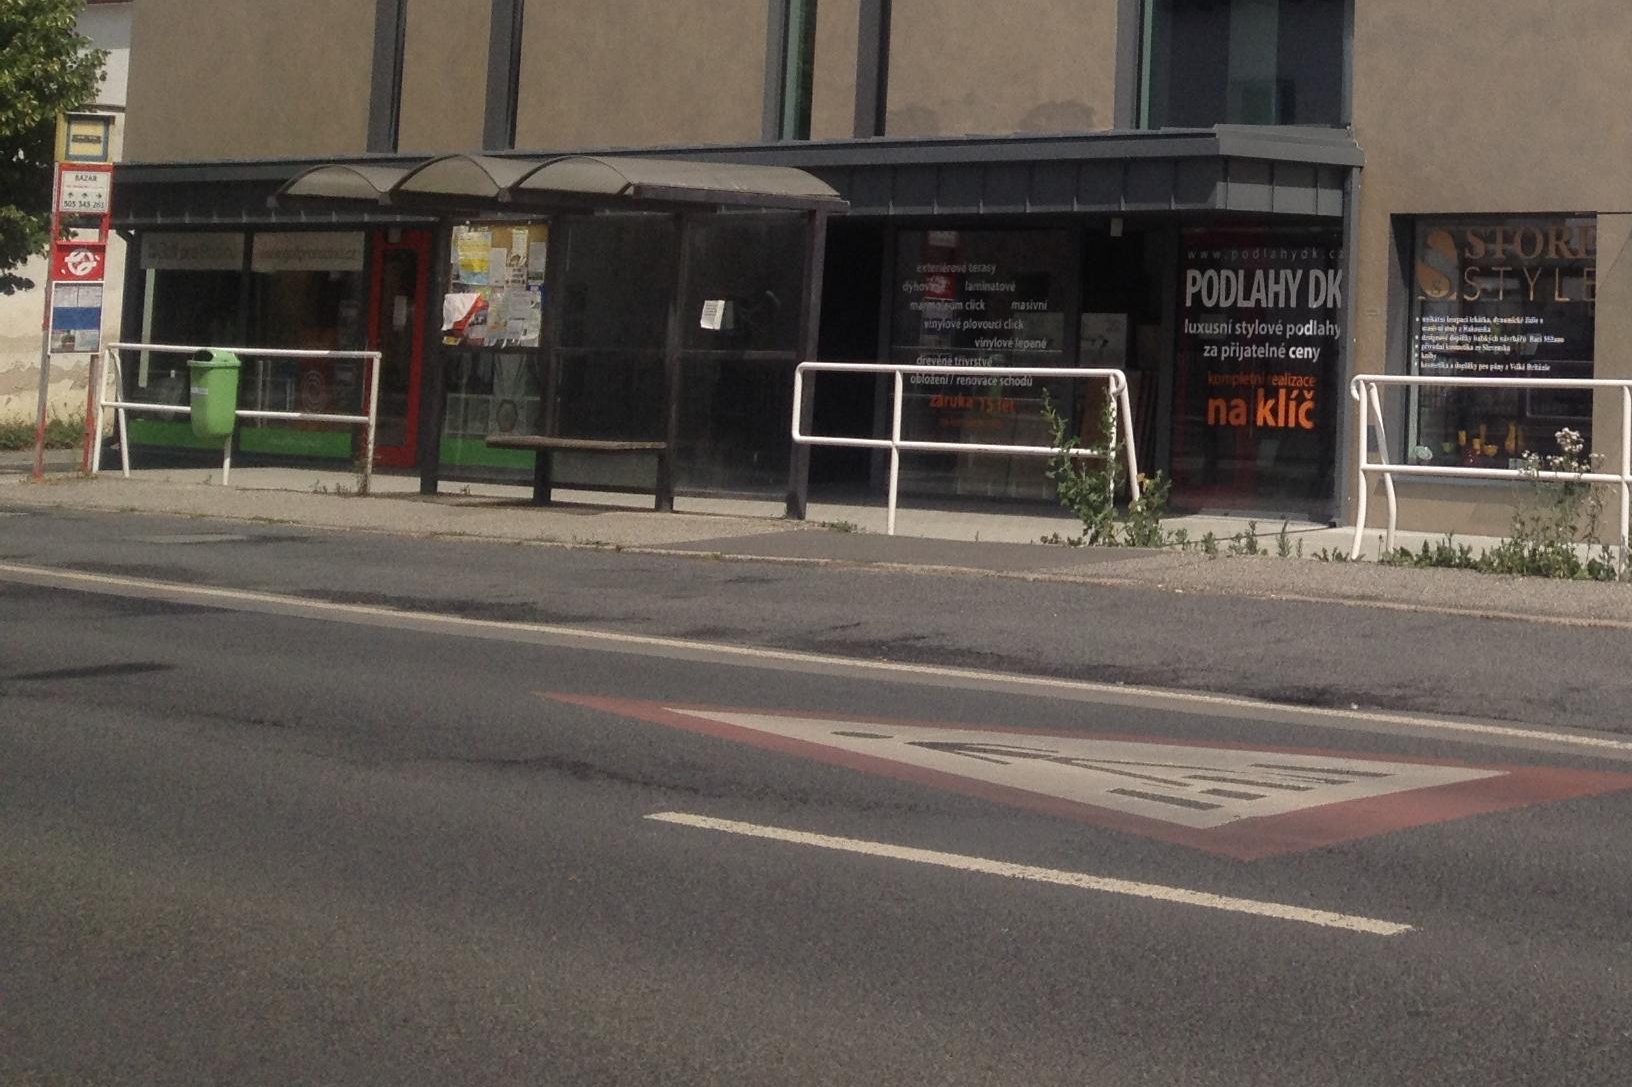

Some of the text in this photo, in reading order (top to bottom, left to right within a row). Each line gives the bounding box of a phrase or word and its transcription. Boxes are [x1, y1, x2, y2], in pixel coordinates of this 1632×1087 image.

[968, 264, 997, 275] terasy
[1185, 268, 1343, 308] PODLAHY DK
[1463, 266, 1596, 302] STYLE
[965, 299, 985, 311] click
[1011, 299, 1048, 311] masivní
[924, 317, 1024, 331] vinylové plovoucí click
[1184, 318, 1341, 339] luxusní stylové podlahy
[974, 336, 1047, 350] vinylové lepené
[1203, 342, 1321, 363] za přijatelné ceny
[956, 376, 998, 386] renovace
[1207, 370, 1318, 387] kompletní realizace
[1207, 387, 1316, 430] na klíč
